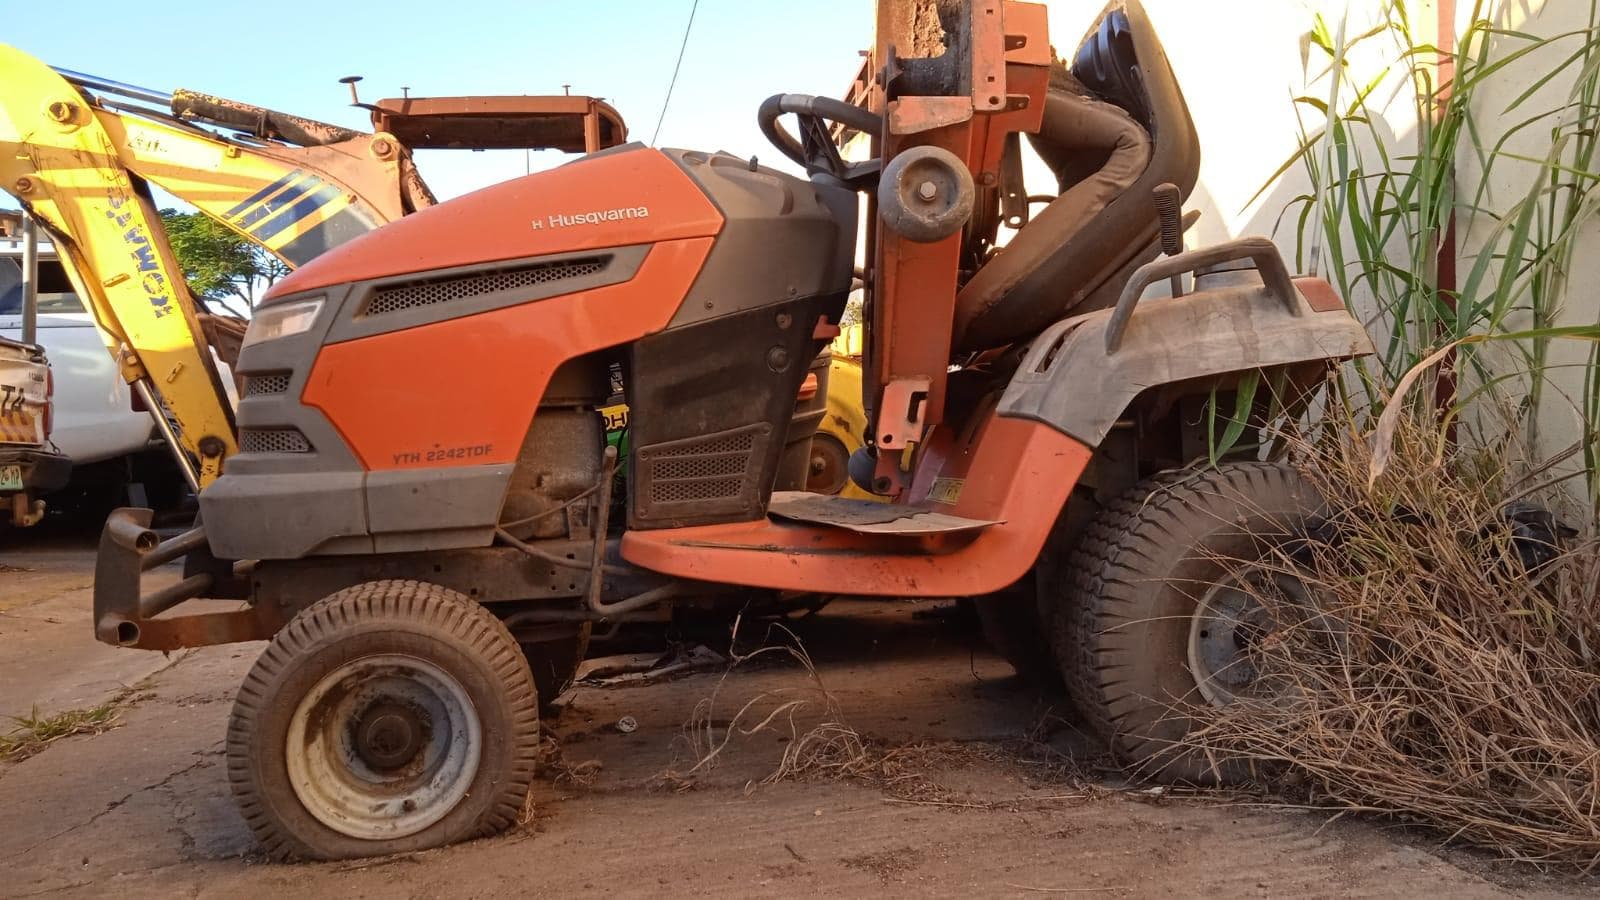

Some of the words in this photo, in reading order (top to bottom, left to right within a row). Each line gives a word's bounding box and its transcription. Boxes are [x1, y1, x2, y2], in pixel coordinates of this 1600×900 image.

[548, 205, 649, 228] Husqvarna
[392, 453, 421, 465] YTH
[426, 444, 493, 462] 2242TDF
